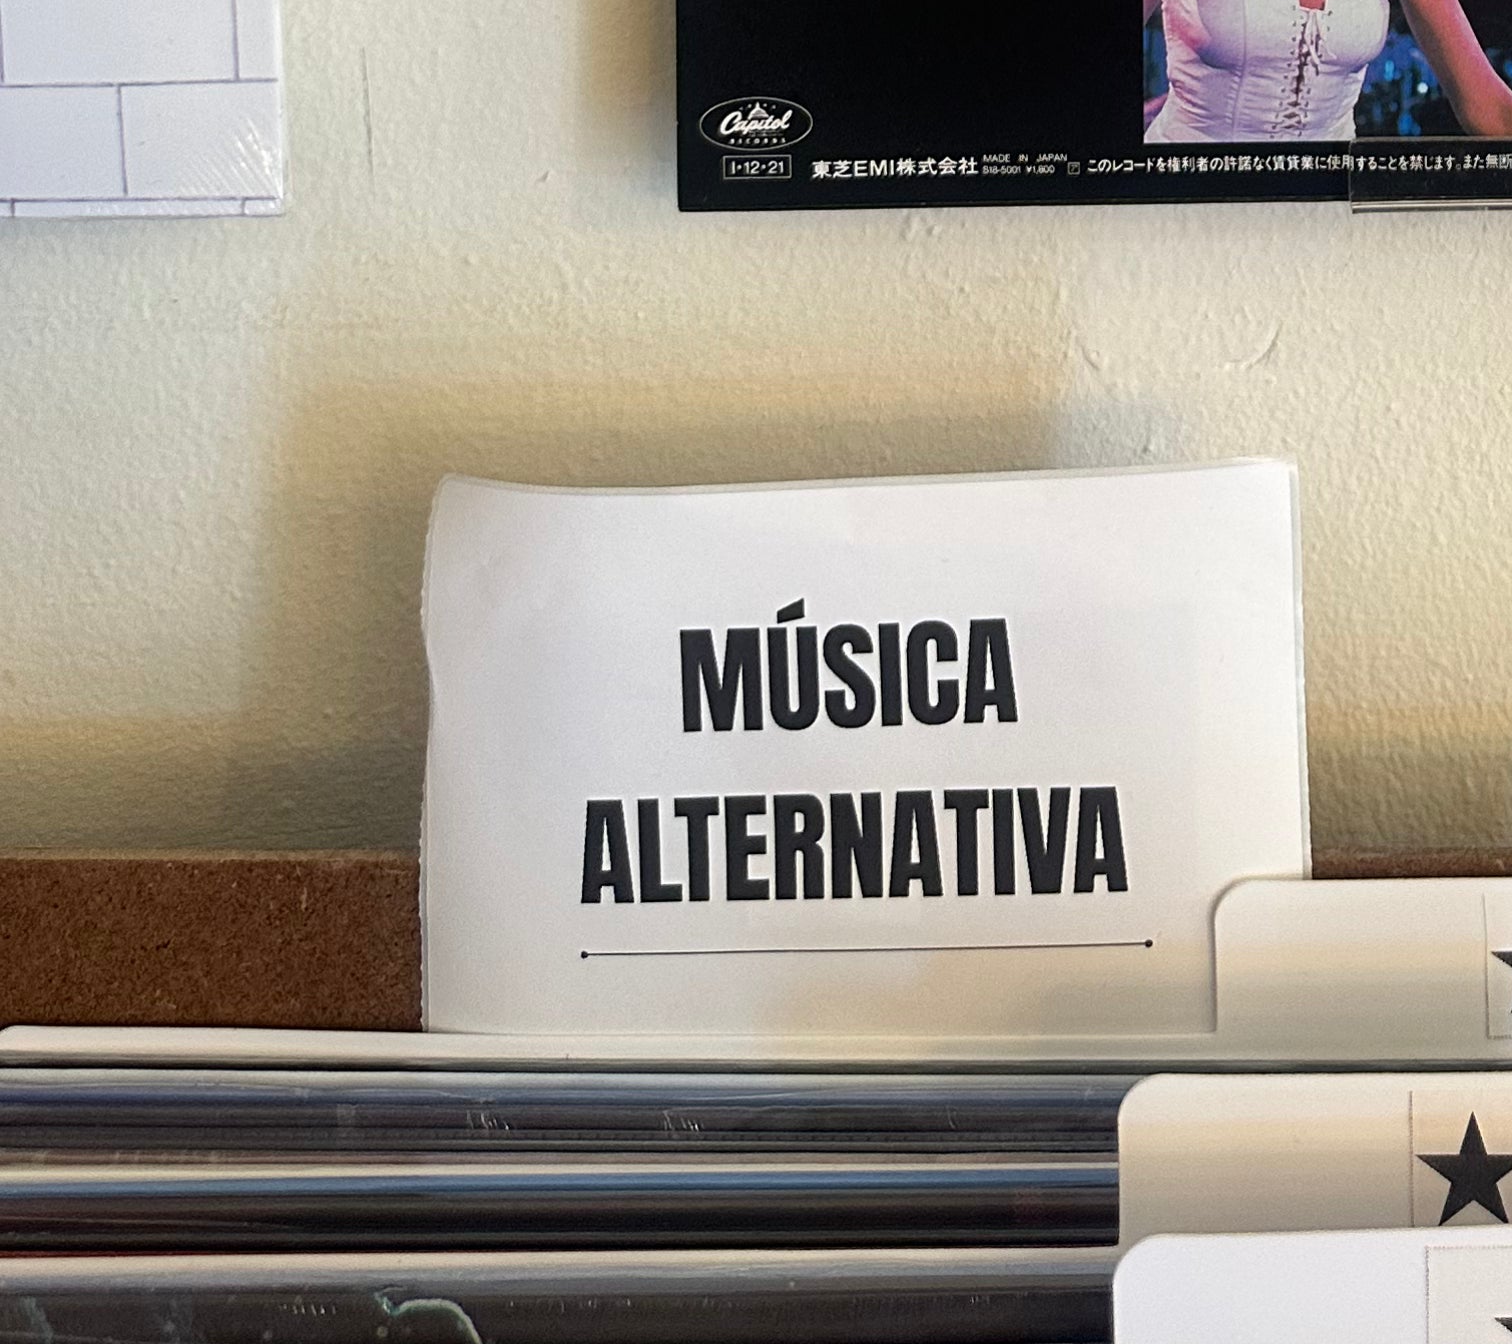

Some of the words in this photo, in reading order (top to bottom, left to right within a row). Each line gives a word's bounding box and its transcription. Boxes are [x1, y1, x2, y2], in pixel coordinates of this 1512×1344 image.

[720, 110, 793, 135] Capitol
[812, 156, 979, 179] 東芝EMI株式会社
[983, 153, 1010, 163] MADE
[1018, 153, 1029, 163] IN
[1036, 153, 1068, 163] JAPAN
[679, 598, 1019, 733] MÚSICA
[581, 785, 1129, 904] ALTERNATIVA
